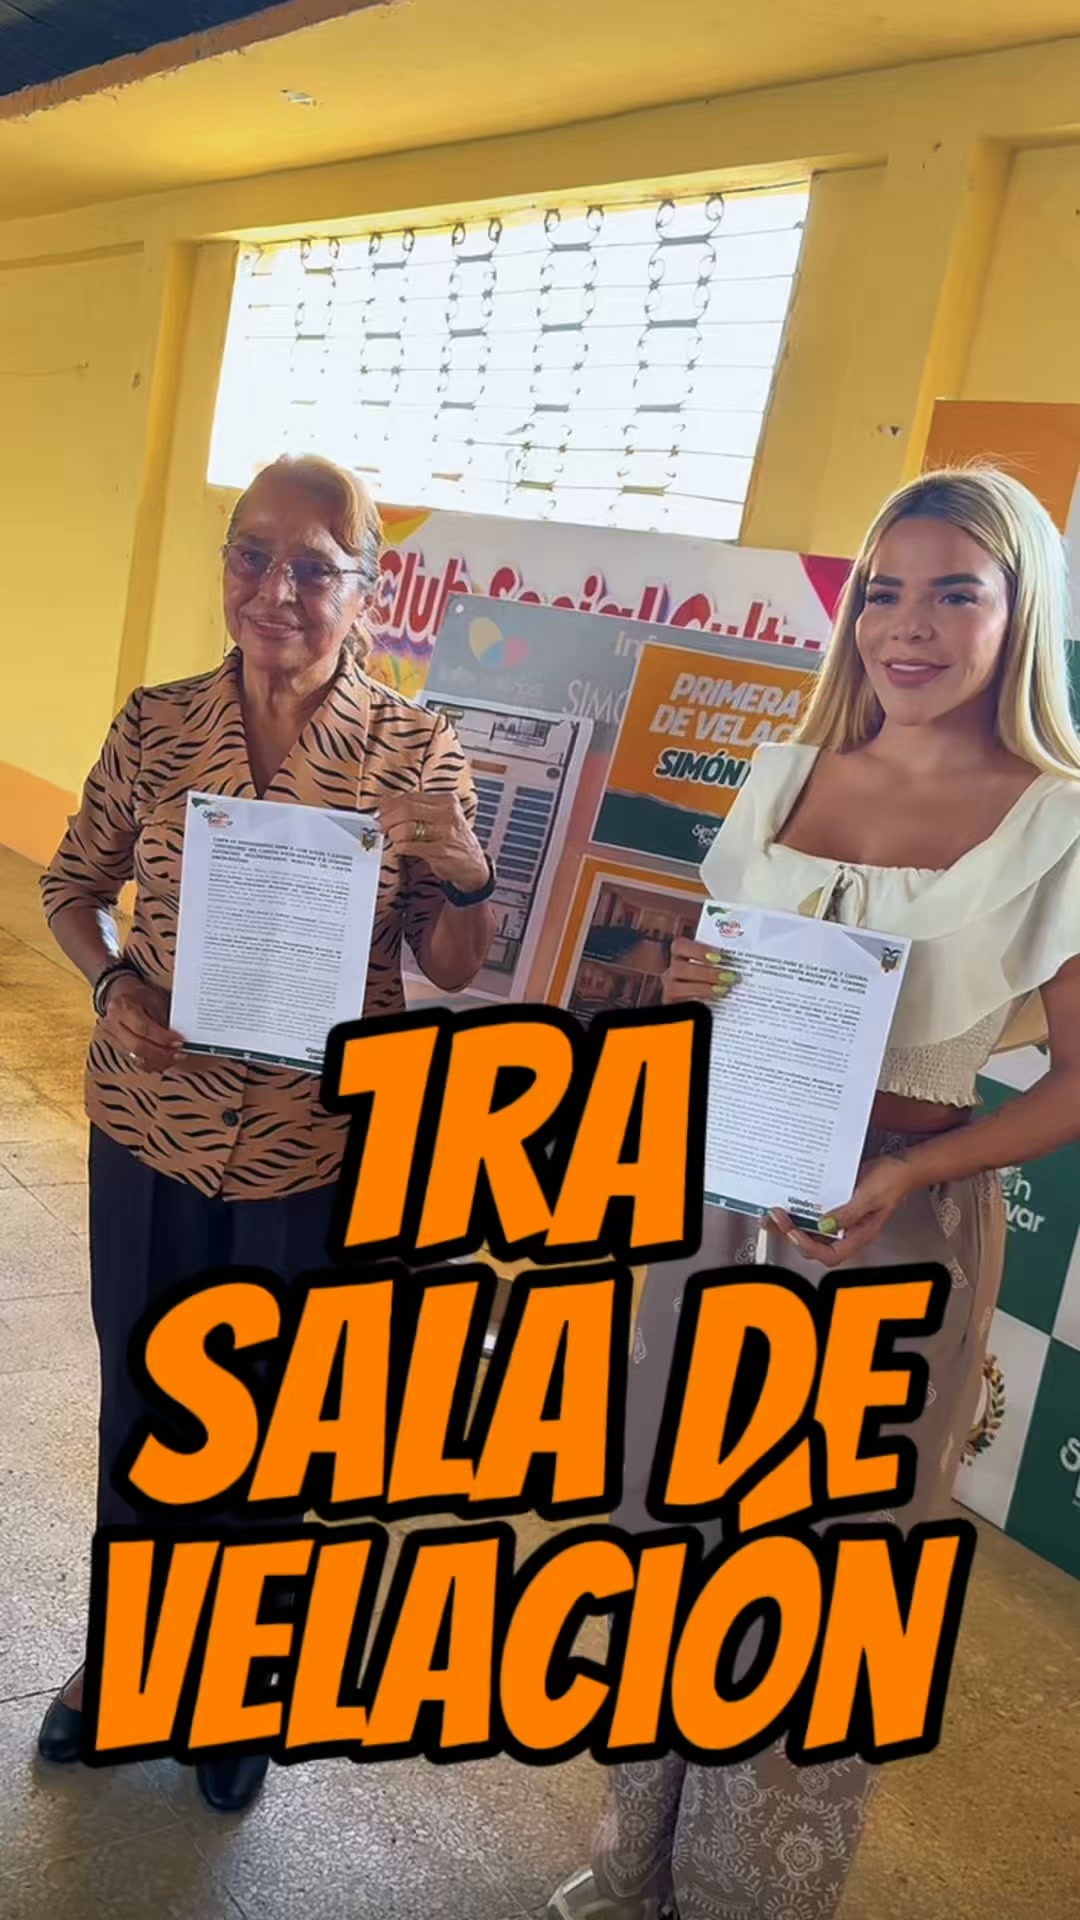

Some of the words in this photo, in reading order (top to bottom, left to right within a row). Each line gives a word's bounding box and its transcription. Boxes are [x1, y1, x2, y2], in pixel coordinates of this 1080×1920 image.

[669, 671, 801, 719] PRIMERA
[649, 704, 697, 738] DE
[654, 748, 747, 788] SIMÓN
